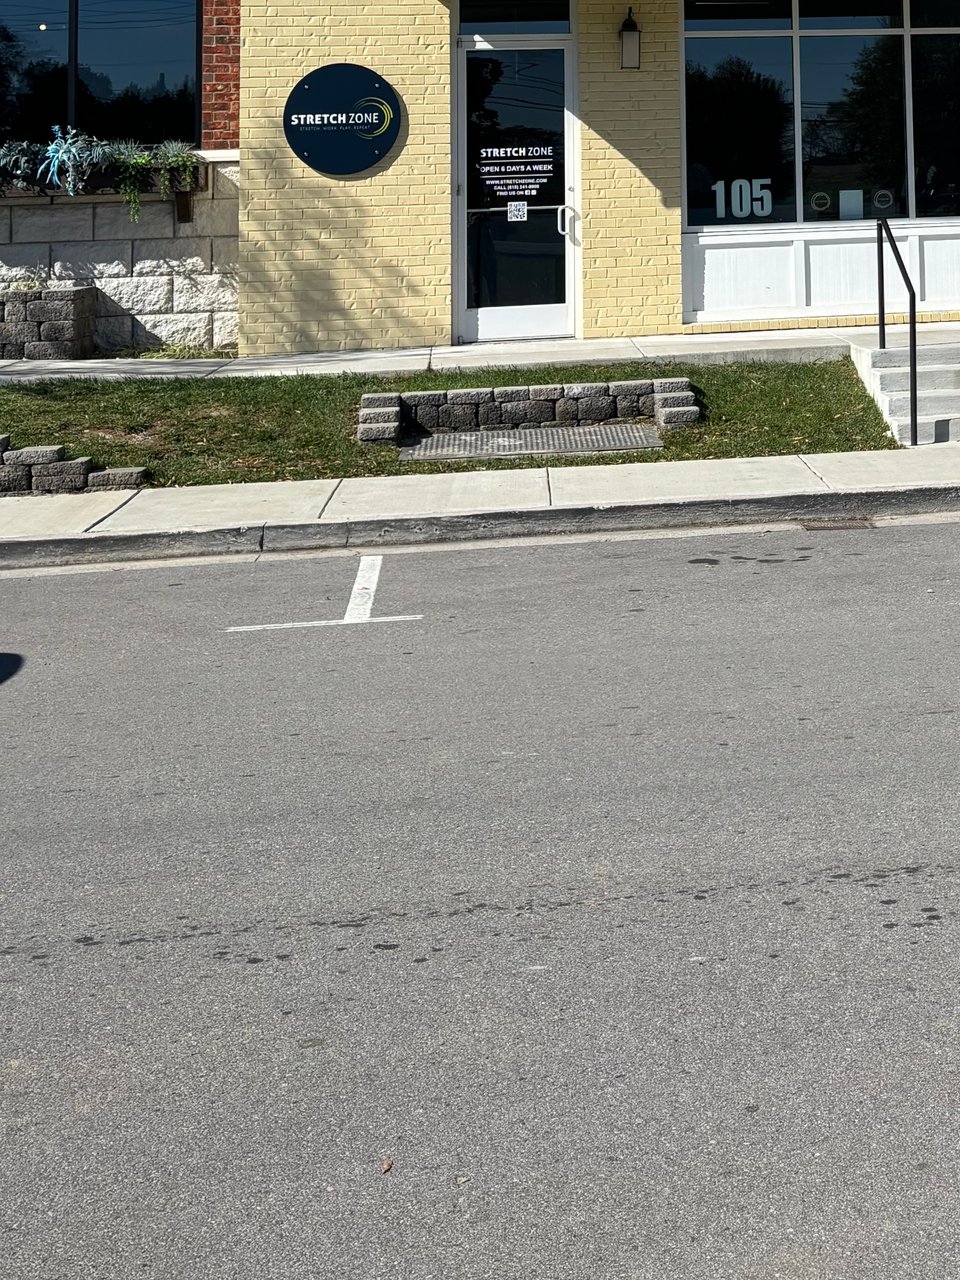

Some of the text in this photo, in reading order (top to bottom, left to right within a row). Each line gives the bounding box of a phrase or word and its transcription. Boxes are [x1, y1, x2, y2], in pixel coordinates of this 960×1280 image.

[290, 112, 379, 125] STRETCH ZONE
[480, 146, 553, 157] STRETCH ZONE
[711, 178, 773, 219] 105
